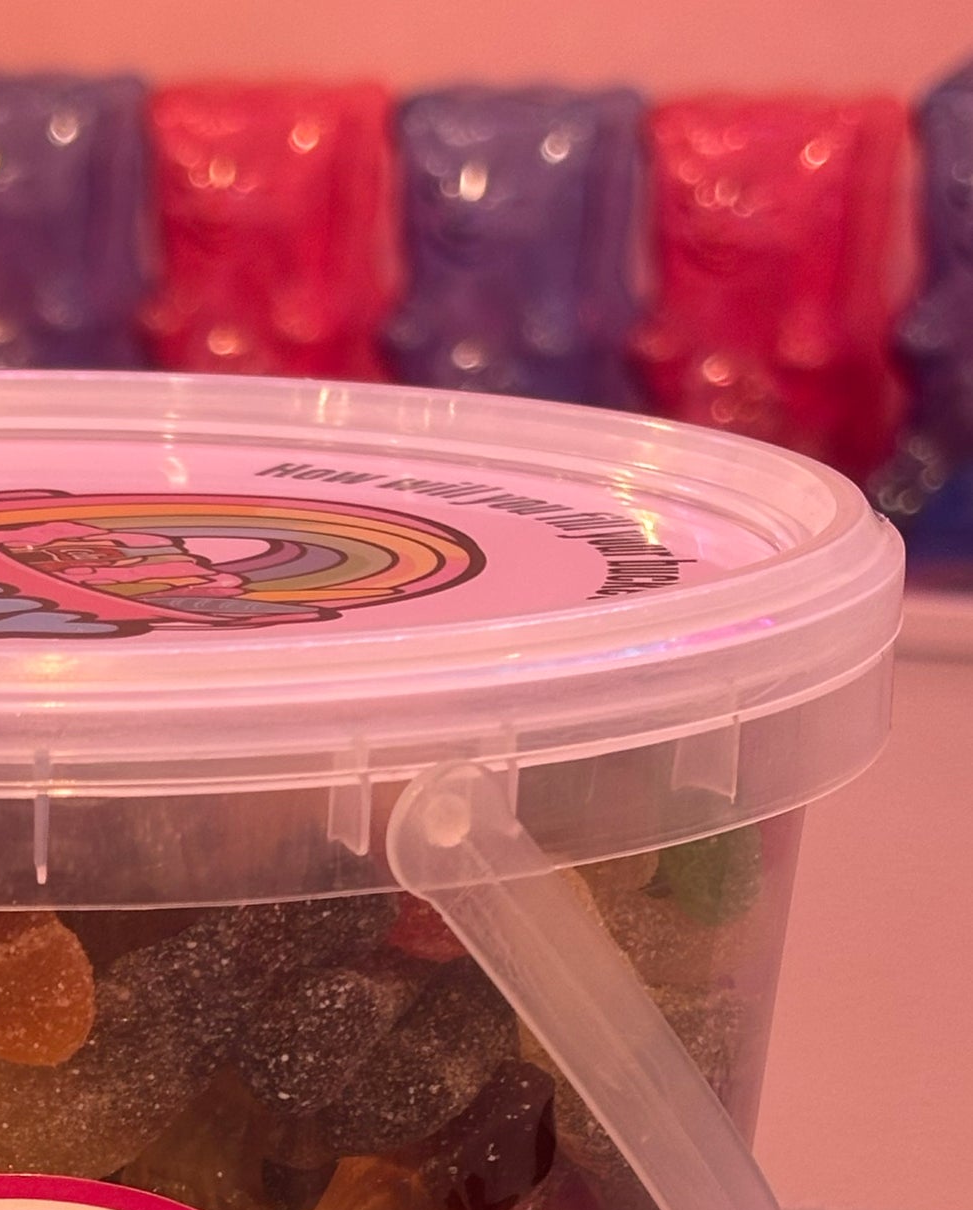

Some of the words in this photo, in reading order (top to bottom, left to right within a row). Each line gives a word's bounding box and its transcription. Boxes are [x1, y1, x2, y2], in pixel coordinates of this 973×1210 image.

[255, 463, 388, 484] How
[377, 478, 503, 498] will
[449, 493, 574, 515] you
[535, 512, 640, 531] fill
[555, 530, 675, 557] your
